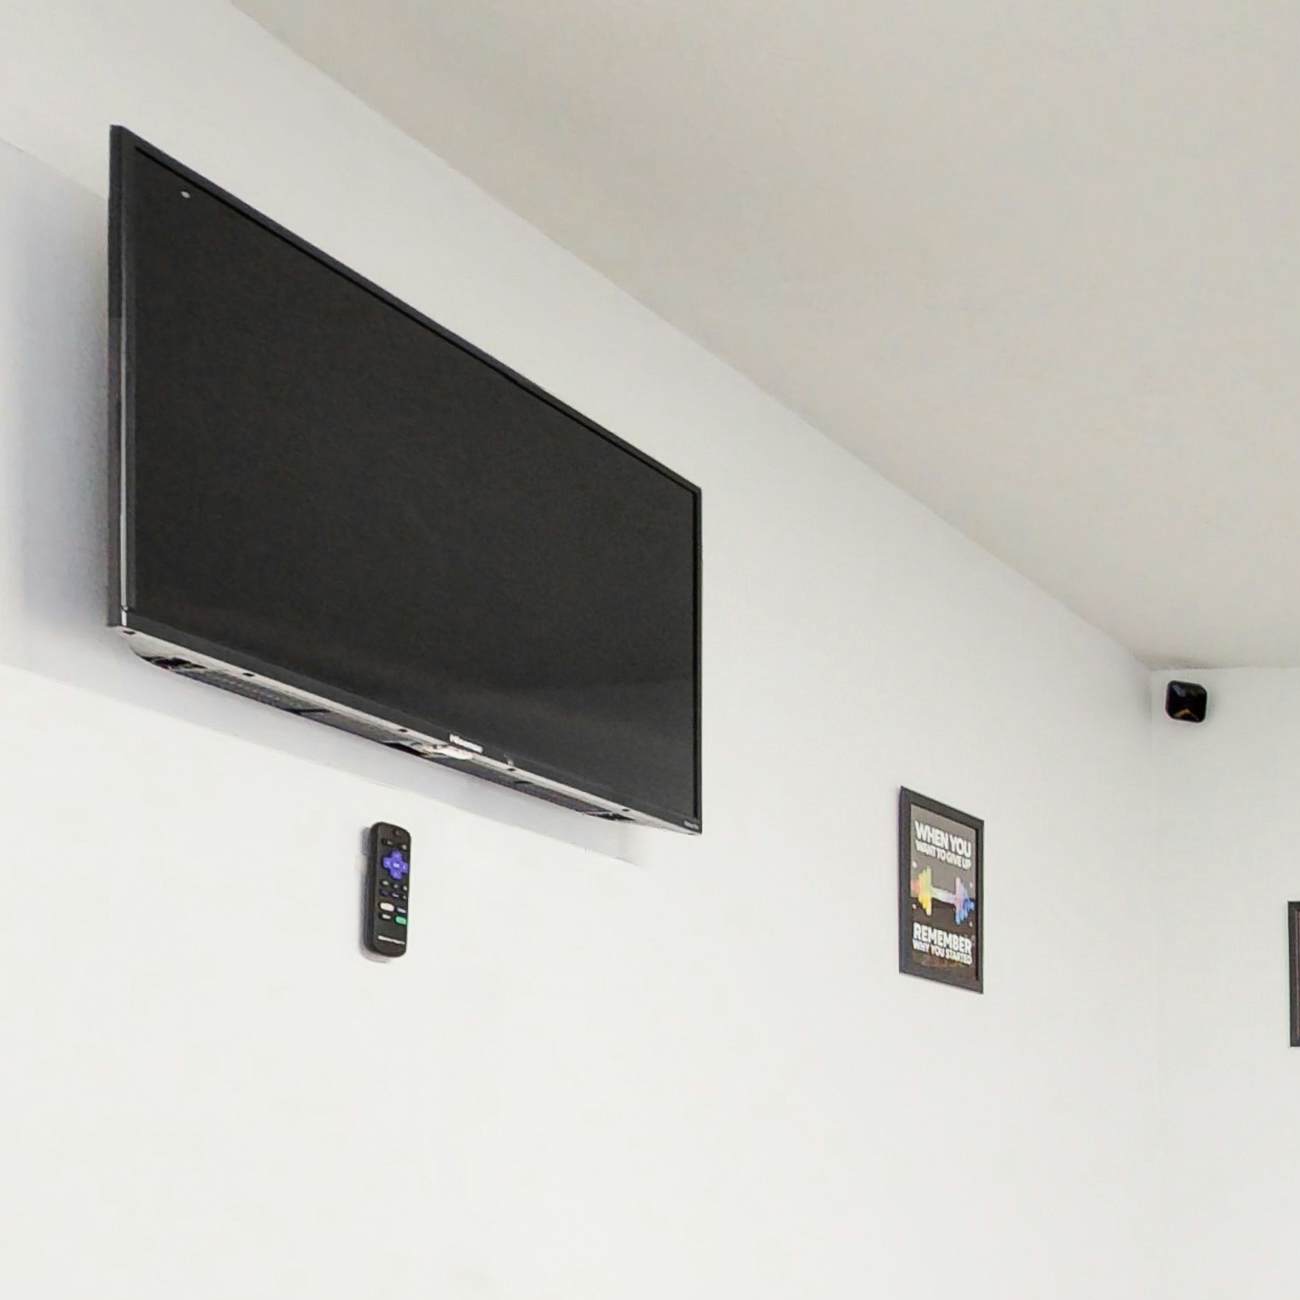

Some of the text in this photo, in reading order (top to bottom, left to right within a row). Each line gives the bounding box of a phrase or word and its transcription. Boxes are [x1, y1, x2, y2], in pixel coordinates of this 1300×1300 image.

[914, 820, 972, 858] WHEN YOU
[936, 847, 946, 861] TO
[961, 857, 972, 870] UP
[912, 921, 972, 955] REMEMBER
[930, 944, 946, 959] YOU
